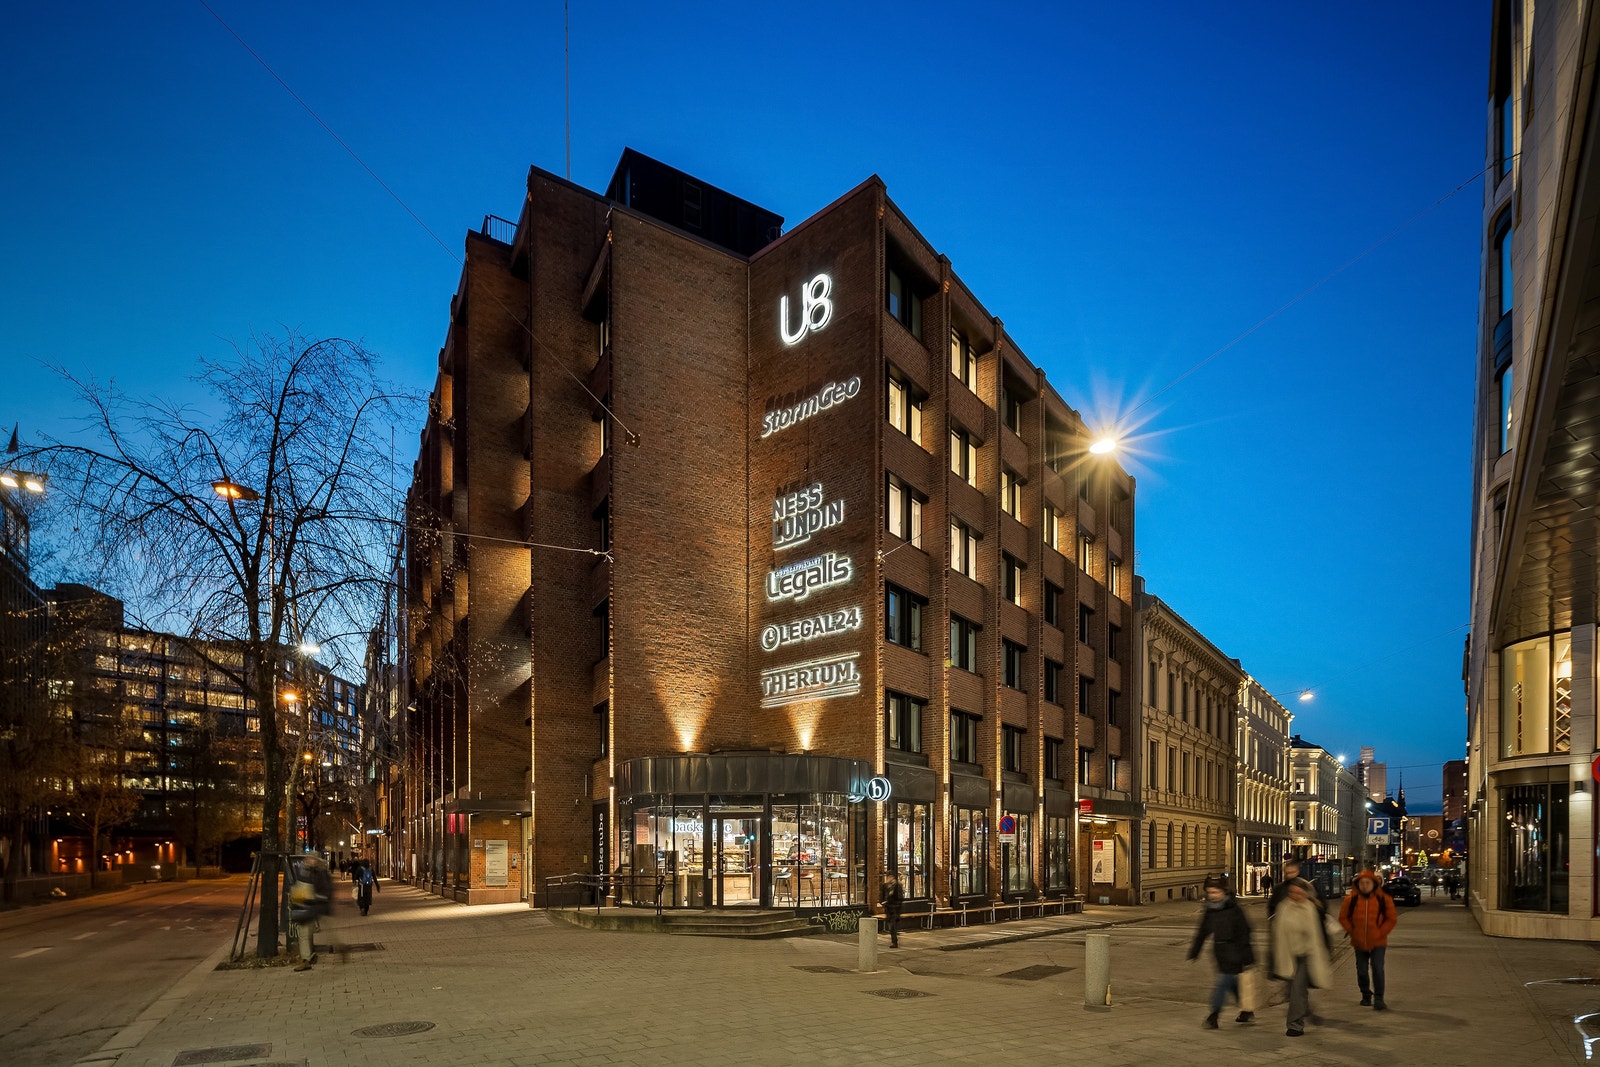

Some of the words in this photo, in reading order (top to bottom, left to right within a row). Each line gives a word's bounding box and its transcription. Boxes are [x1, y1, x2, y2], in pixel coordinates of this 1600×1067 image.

[780, 273, 832, 344] U8
[761, 376, 861, 438] StormGeo
[773, 483, 822, 522] NESS
[773, 500, 843, 545] LUNDIN
[766, 553, 850, 600] Legalis
[779, 607, 860, 645] LEGAL24
[761, 661, 860, 696] THERIUM.
[1373, 820, 1384, 833] P
